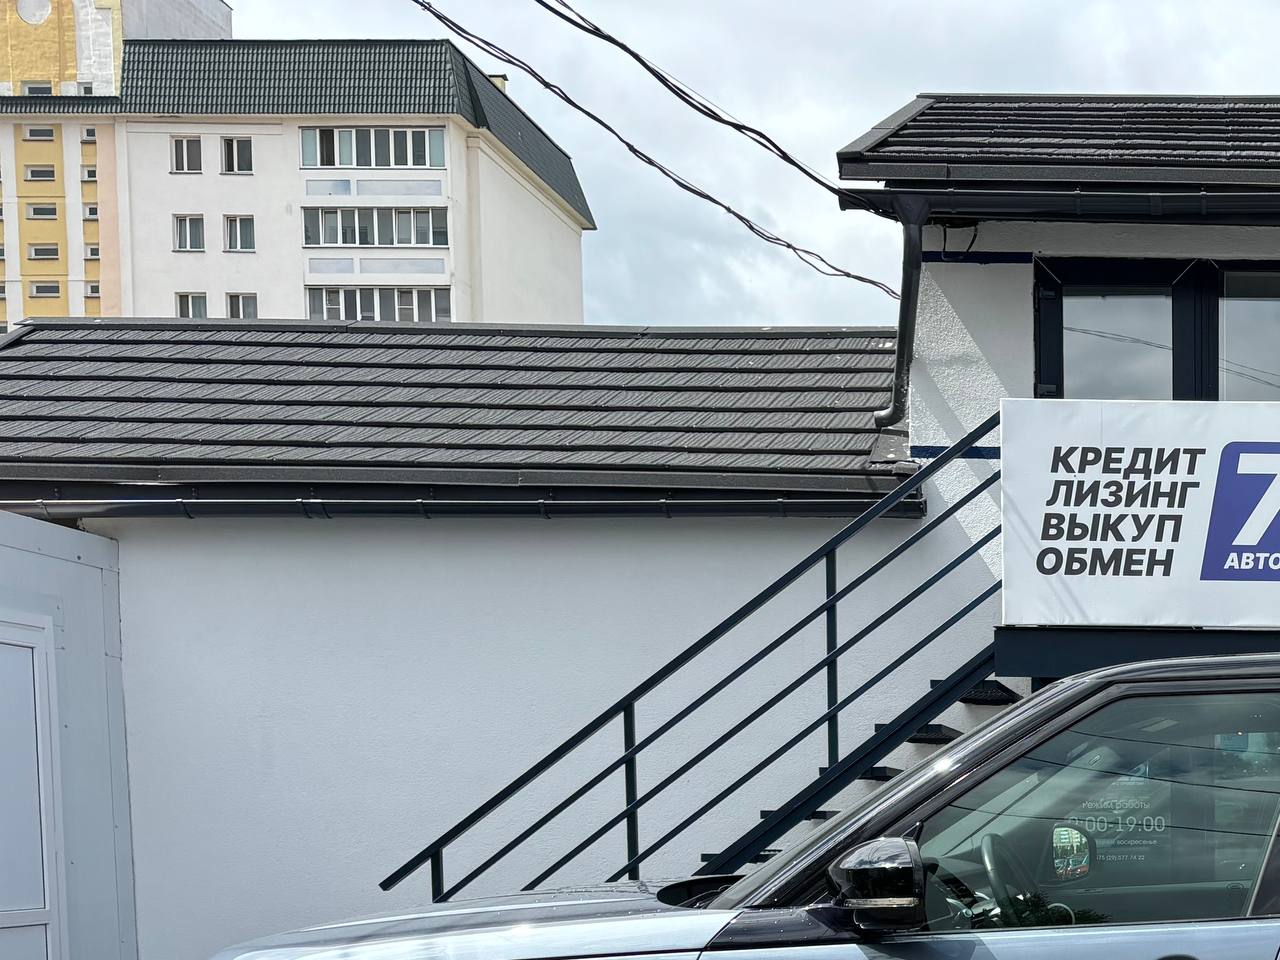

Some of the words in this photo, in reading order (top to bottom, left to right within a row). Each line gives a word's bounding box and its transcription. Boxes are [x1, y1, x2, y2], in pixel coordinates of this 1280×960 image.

[1050, 446, 1207, 481] КРЕДИТ
[1045, 479, 1201, 509] ЛИЗИНГ
[1040, 512, 1183, 543] ВЫКУП
[1035, 546, 1175, 577] ОБМЕН
